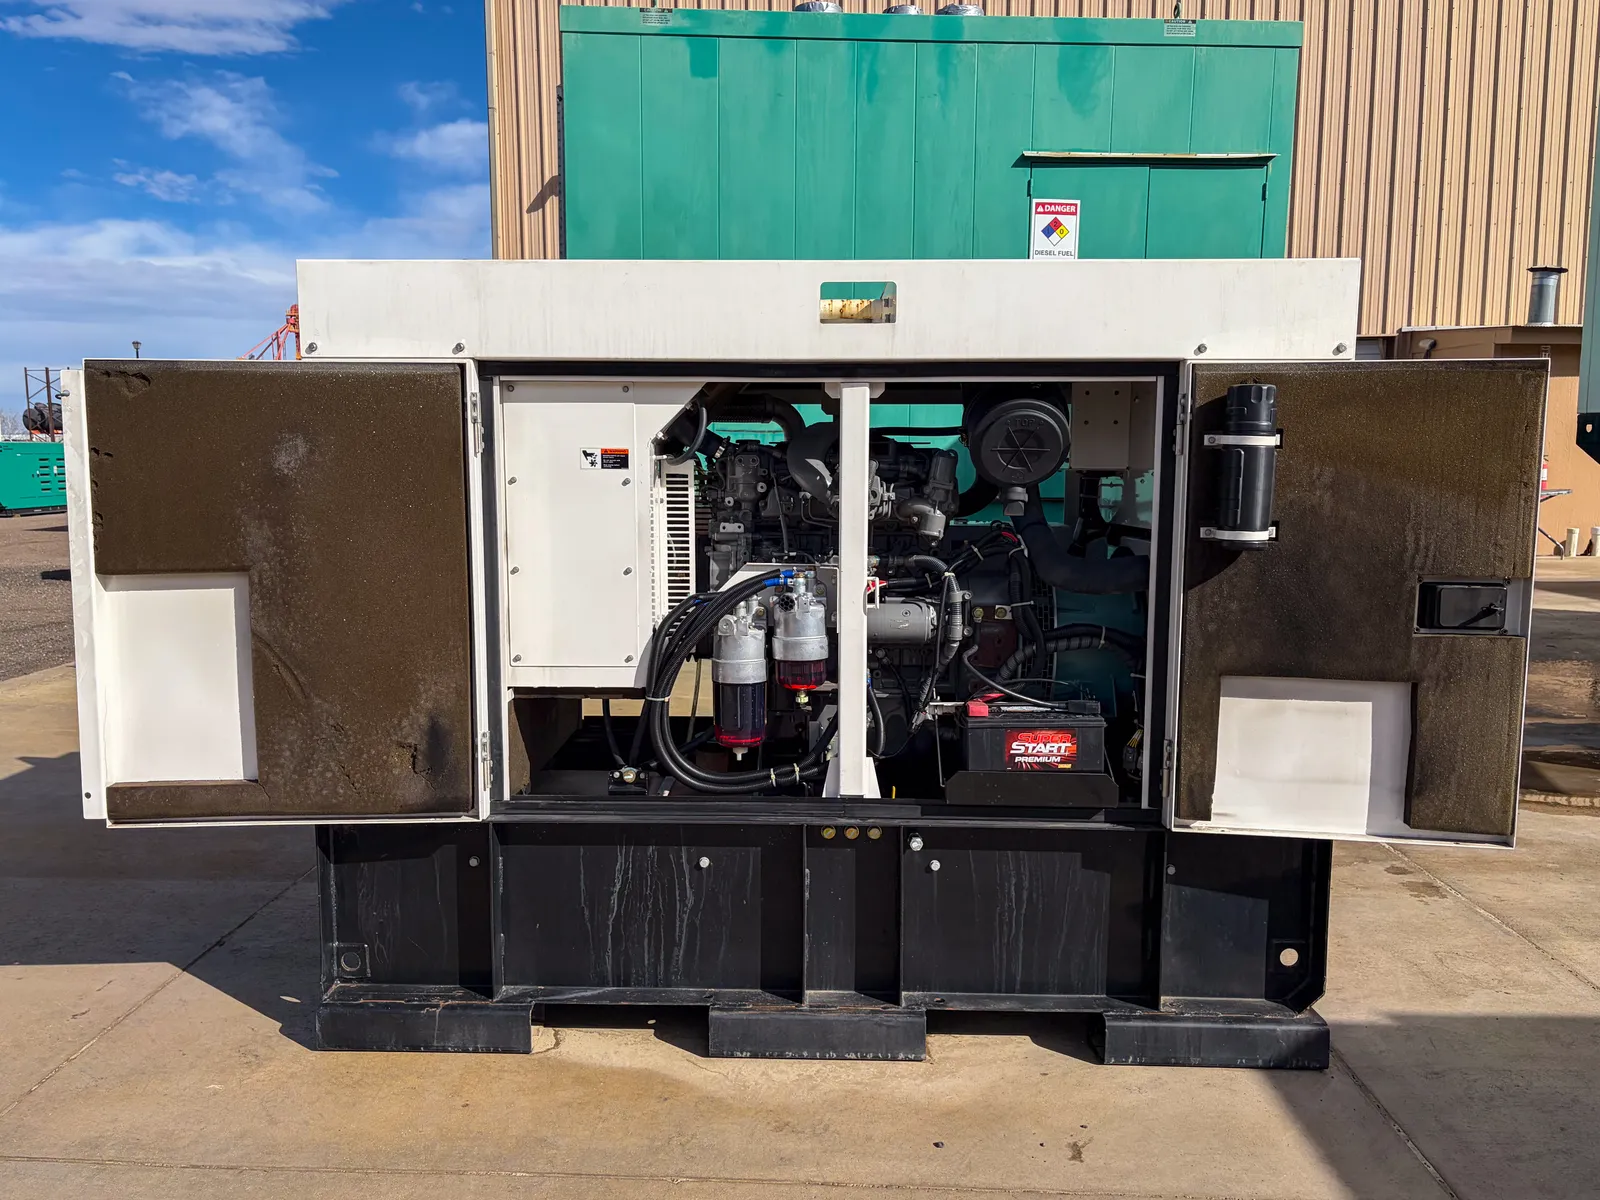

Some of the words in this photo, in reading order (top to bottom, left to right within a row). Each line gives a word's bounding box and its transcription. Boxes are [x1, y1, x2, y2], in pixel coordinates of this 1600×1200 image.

[1044, 204, 1076, 213] DANGER
[1015, 418, 1035, 427] TOP
[1017, 732, 1072, 743] SUPER
[1010, 741, 1072, 754] START
